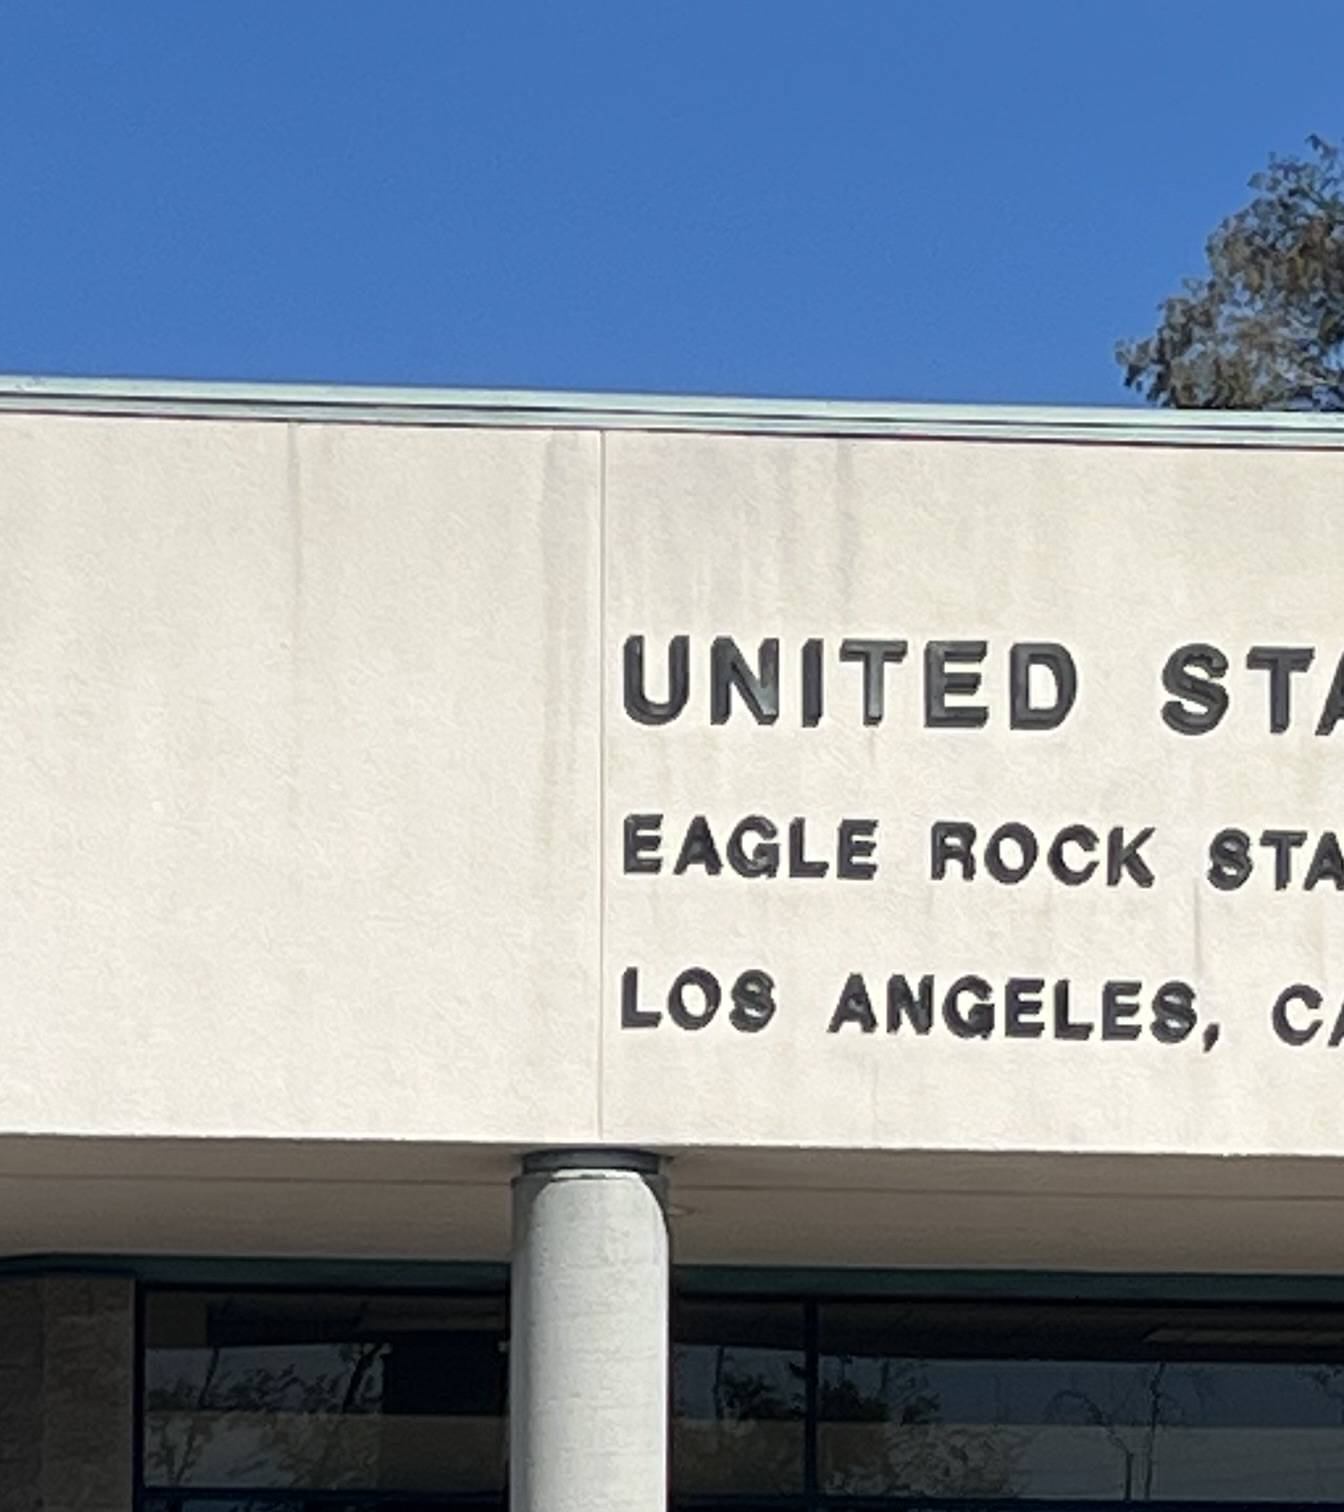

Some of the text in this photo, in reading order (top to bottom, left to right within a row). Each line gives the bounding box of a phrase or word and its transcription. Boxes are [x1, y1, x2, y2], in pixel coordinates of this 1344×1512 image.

[624, 636, 1077, 729] UNITED
[623, 815, 878, 880] EAGLE
[931, 822, 1156, 887] ROCK
[622, 968, 776, 1032] LOS
[829, 975, 1219, 1052] ANGELES,
